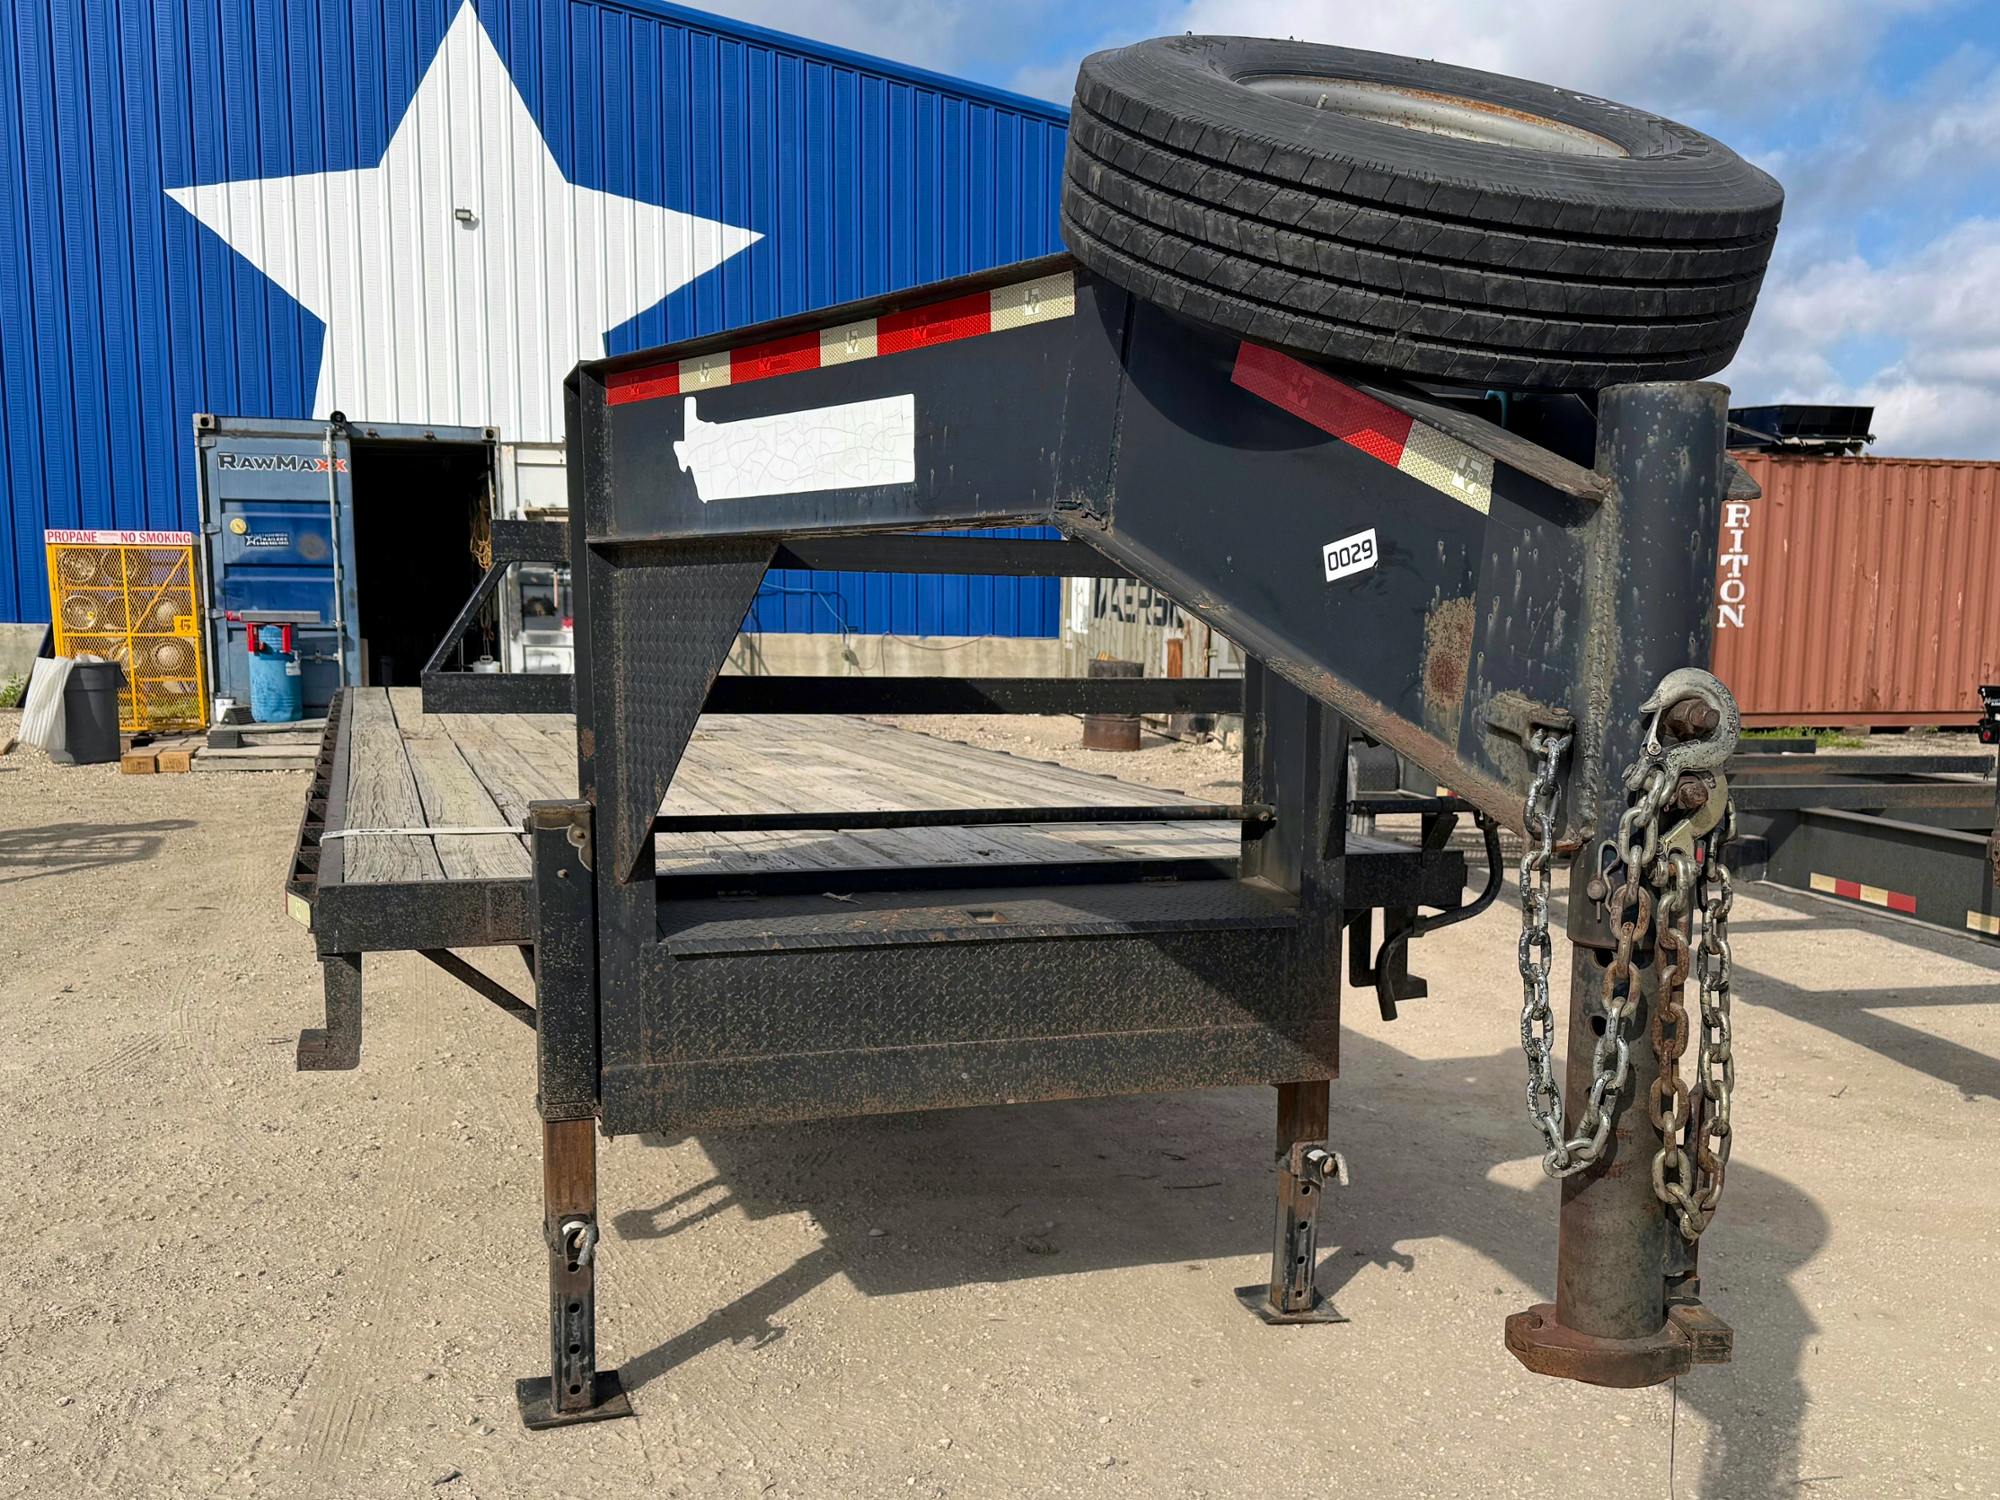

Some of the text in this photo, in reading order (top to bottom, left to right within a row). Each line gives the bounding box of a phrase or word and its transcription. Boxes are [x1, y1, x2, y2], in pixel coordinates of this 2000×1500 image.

[47, 531, 97, 543] PROPANE
[120, 532, 136, 543] NO
[139, 533, 191, 544] SMOKING
[1327, 538, 1374, 572] 0029
[1716, 502, 1751, 629] RITON
